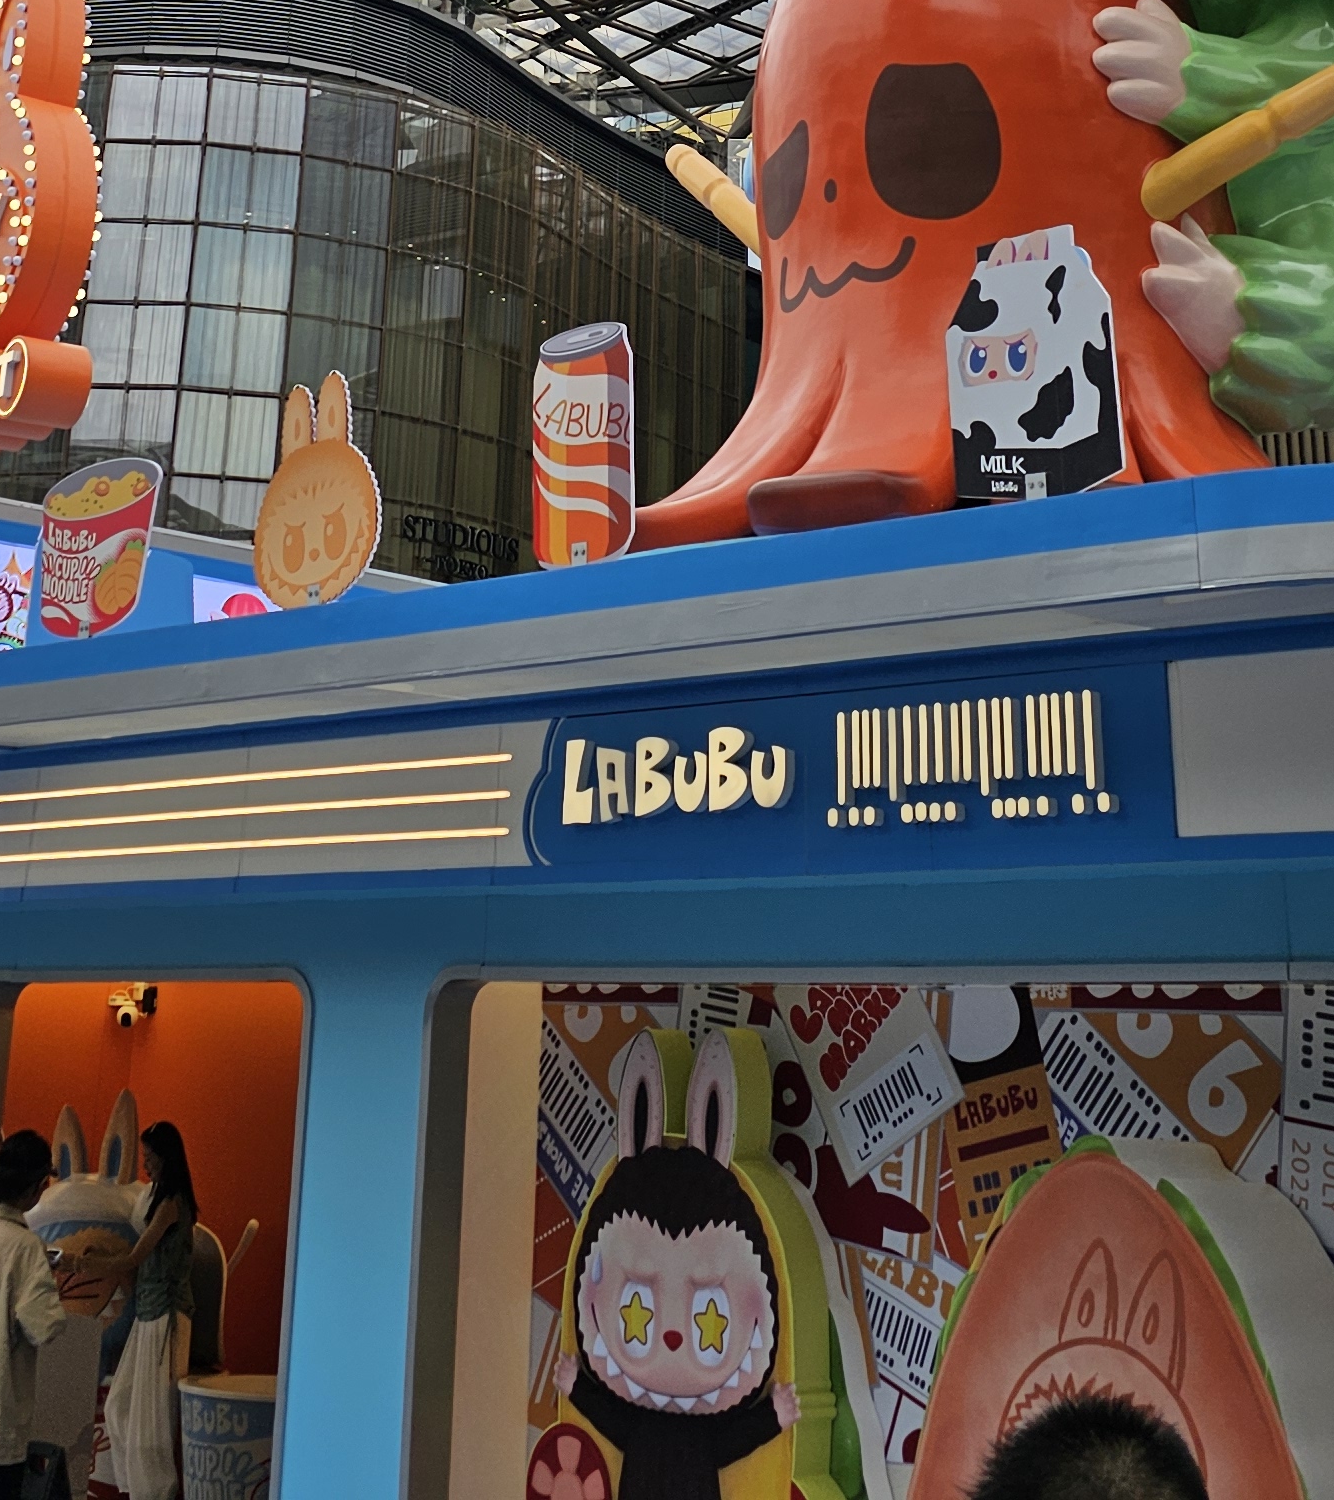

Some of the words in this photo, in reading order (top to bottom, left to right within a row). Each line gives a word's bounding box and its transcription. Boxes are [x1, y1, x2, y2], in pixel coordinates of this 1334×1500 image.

[980, 454, 1027, 475] MILK
[48, 521, 97, 552] LABUBU
[403, 514, 520, 562] STUDIOUS
[54, 554, 81, 581] CUP
[562, 725, 790, 826] LABUBU
[954, 1084, 1037, 1133] LABUBU
